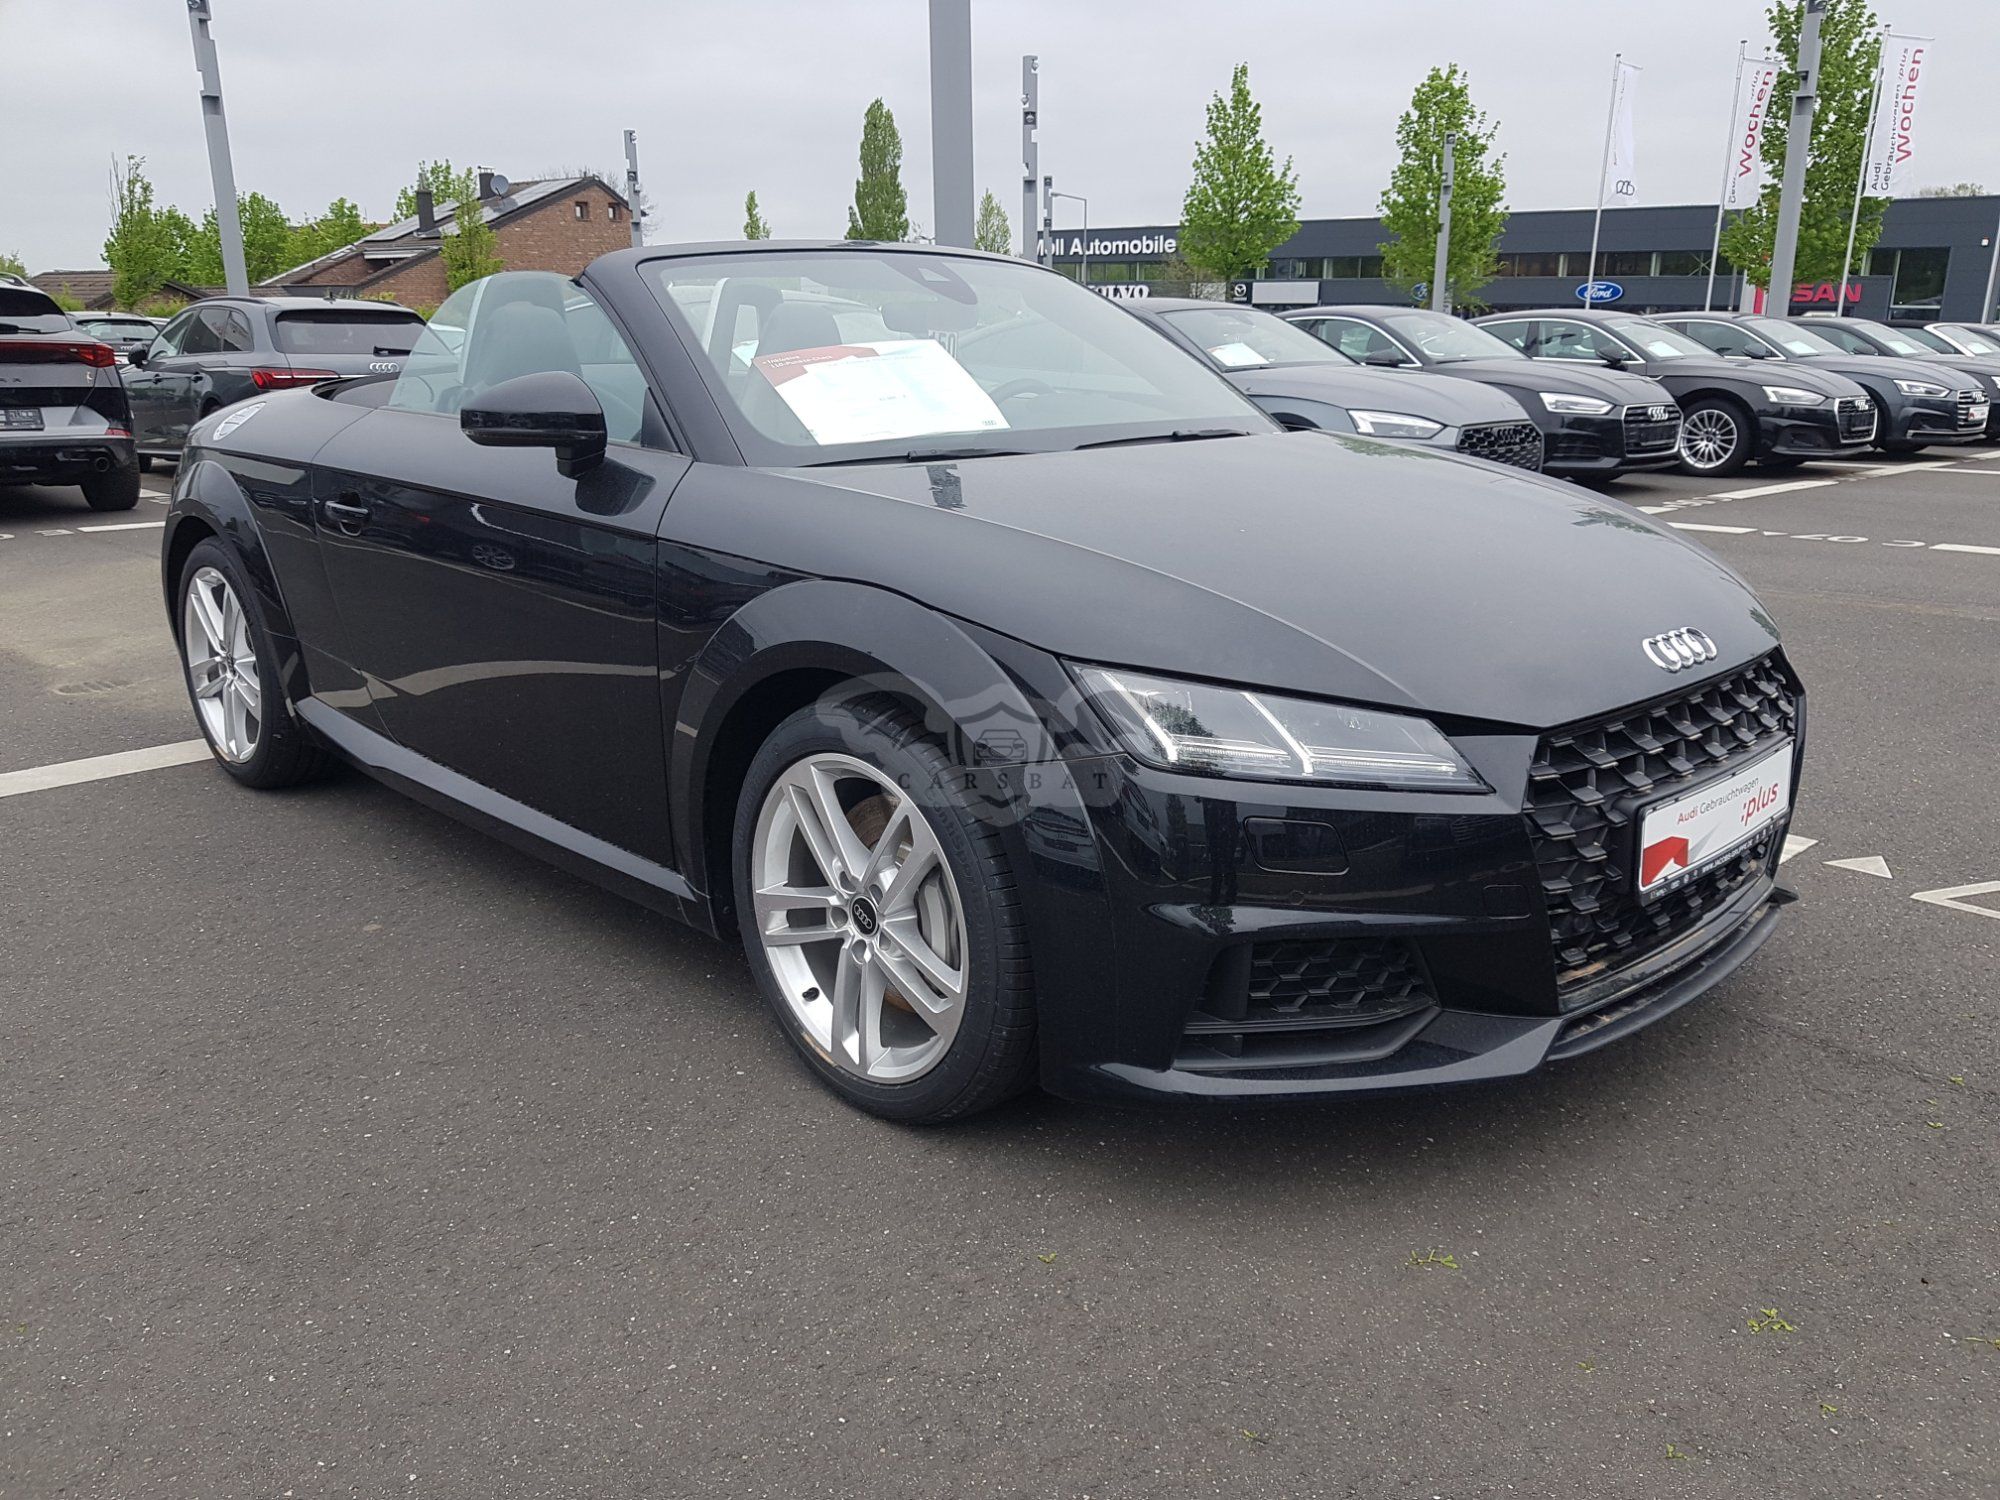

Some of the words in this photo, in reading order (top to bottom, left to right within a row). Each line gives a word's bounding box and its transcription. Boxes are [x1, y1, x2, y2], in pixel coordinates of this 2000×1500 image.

[1895, 48, 1924, 164] Wochen
[1738, 71, 1774, 178] Wochen
[1871, 162, 1883, 191] Audi
[1069, 234, 1176, 256] Automobile
[1088, 285, 1150, 299] OLVO
[1584, 284, 1612, 298] Ford
[1677, 806, 1699, 825] Audi
[1699, 777, 1760, 816] Gebrauchtwagen
